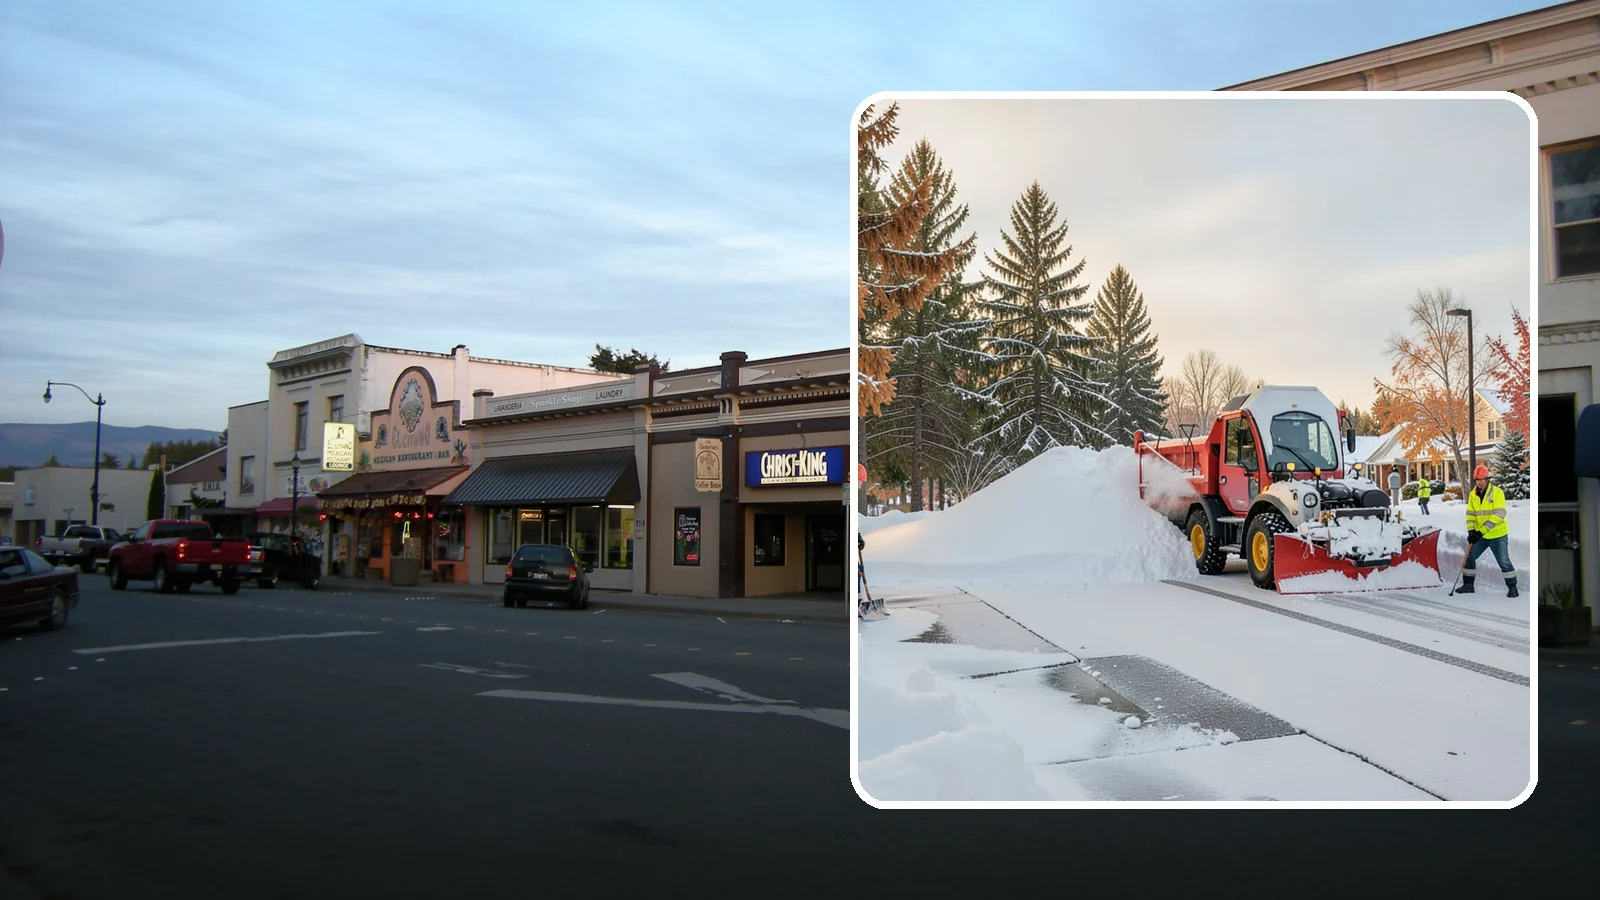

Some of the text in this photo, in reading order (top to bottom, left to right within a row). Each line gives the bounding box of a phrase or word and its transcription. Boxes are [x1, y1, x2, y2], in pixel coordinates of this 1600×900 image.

[595, 389, 623, 400] LAUNDRY
[493, 402, 522, 412] LAVANDERIA
[531, 394, 583, 409] Sparkle Shop
[397, 451, 433, 462] RESTAURANT
[438, 450, 450, 459] BAR
[760, 450, 827, 478] CHRIST KING
